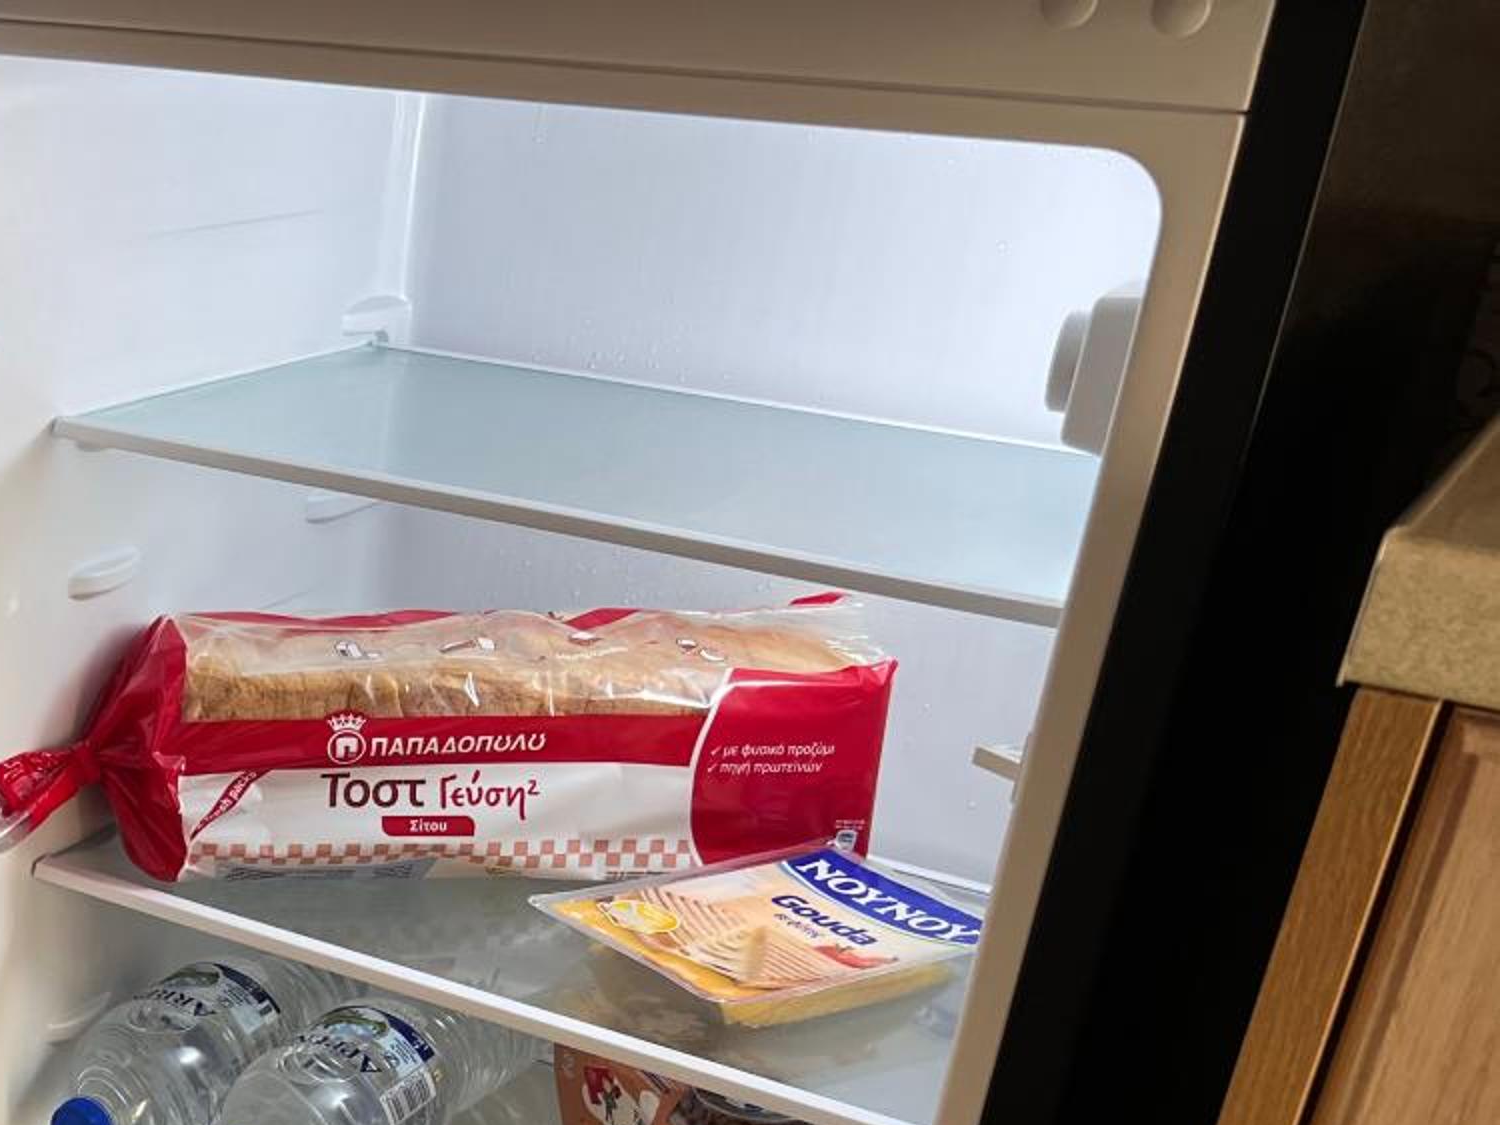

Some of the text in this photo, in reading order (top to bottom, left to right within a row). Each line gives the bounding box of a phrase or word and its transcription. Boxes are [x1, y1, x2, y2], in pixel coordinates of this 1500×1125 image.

[321, 772, 426, 808] Τοστ
[408, 818, 448, 833] Σίτου
[772, 895, 878, 946] Gouda
